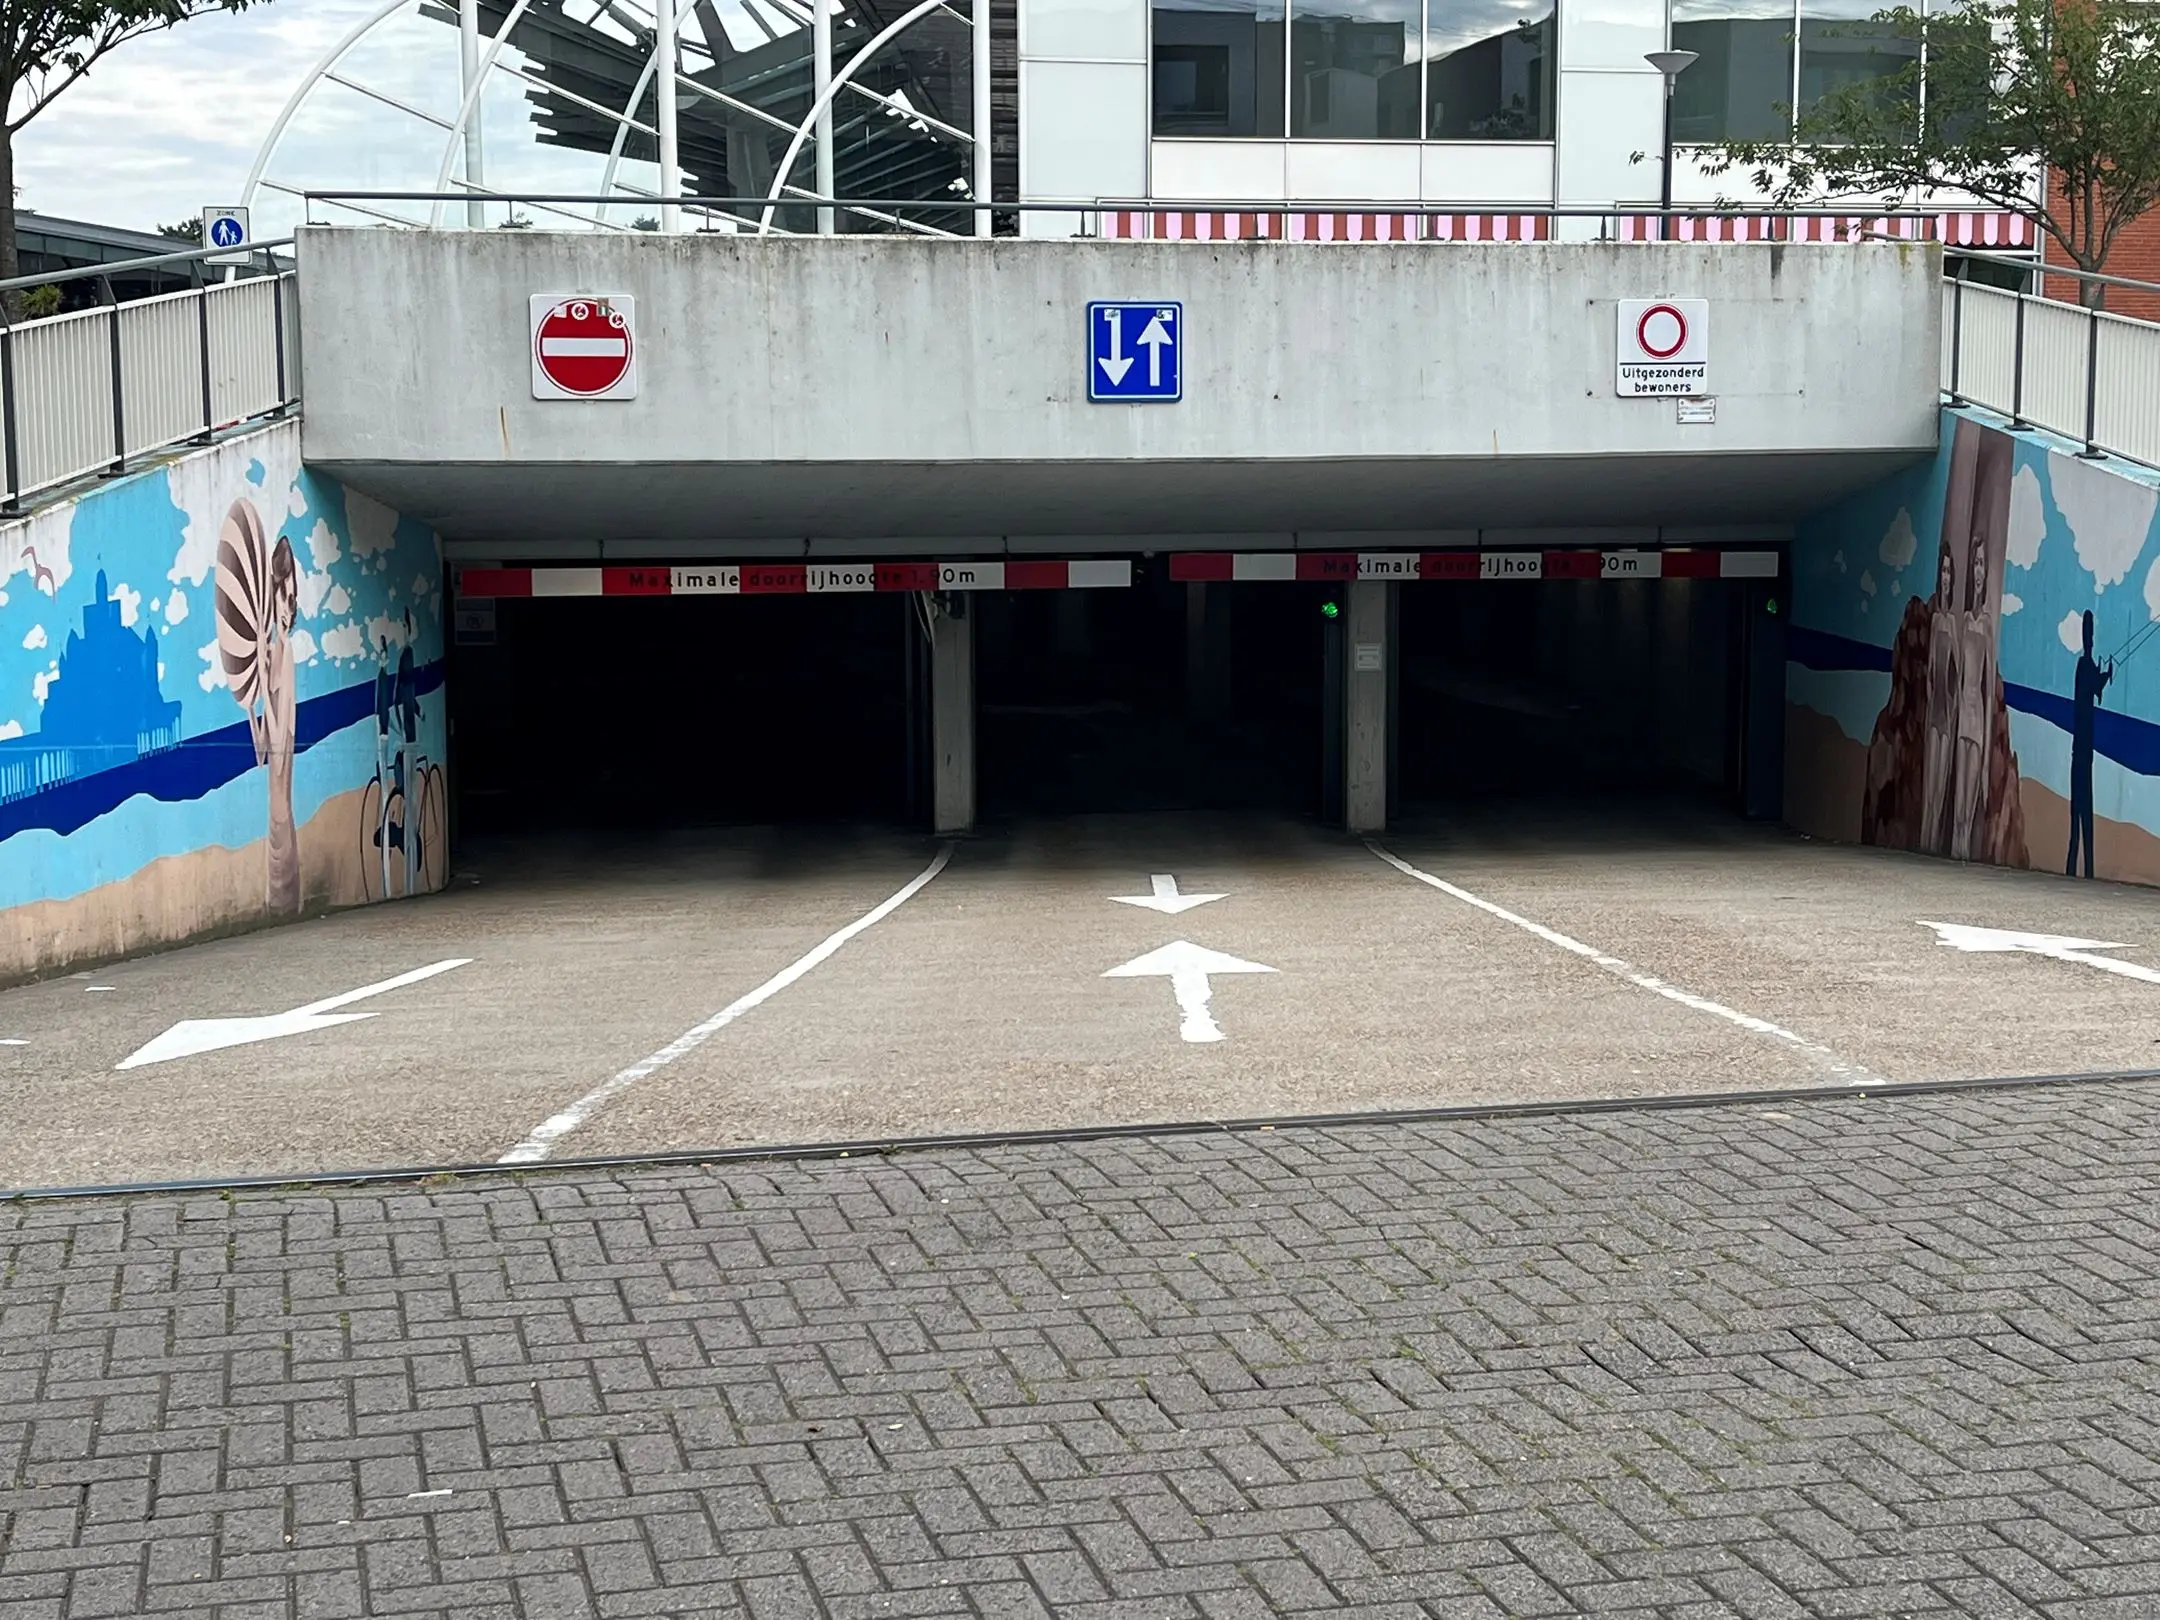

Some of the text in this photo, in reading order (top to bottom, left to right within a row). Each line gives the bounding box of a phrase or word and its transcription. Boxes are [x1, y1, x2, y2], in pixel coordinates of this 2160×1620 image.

[1622, 366, 1704, 381] Uitgezonderd
[1634, 382, 1692, 393] bewoners
[1323, 558, 1422, 574] Maximale
[629, 571, 739, 588] Maximale
